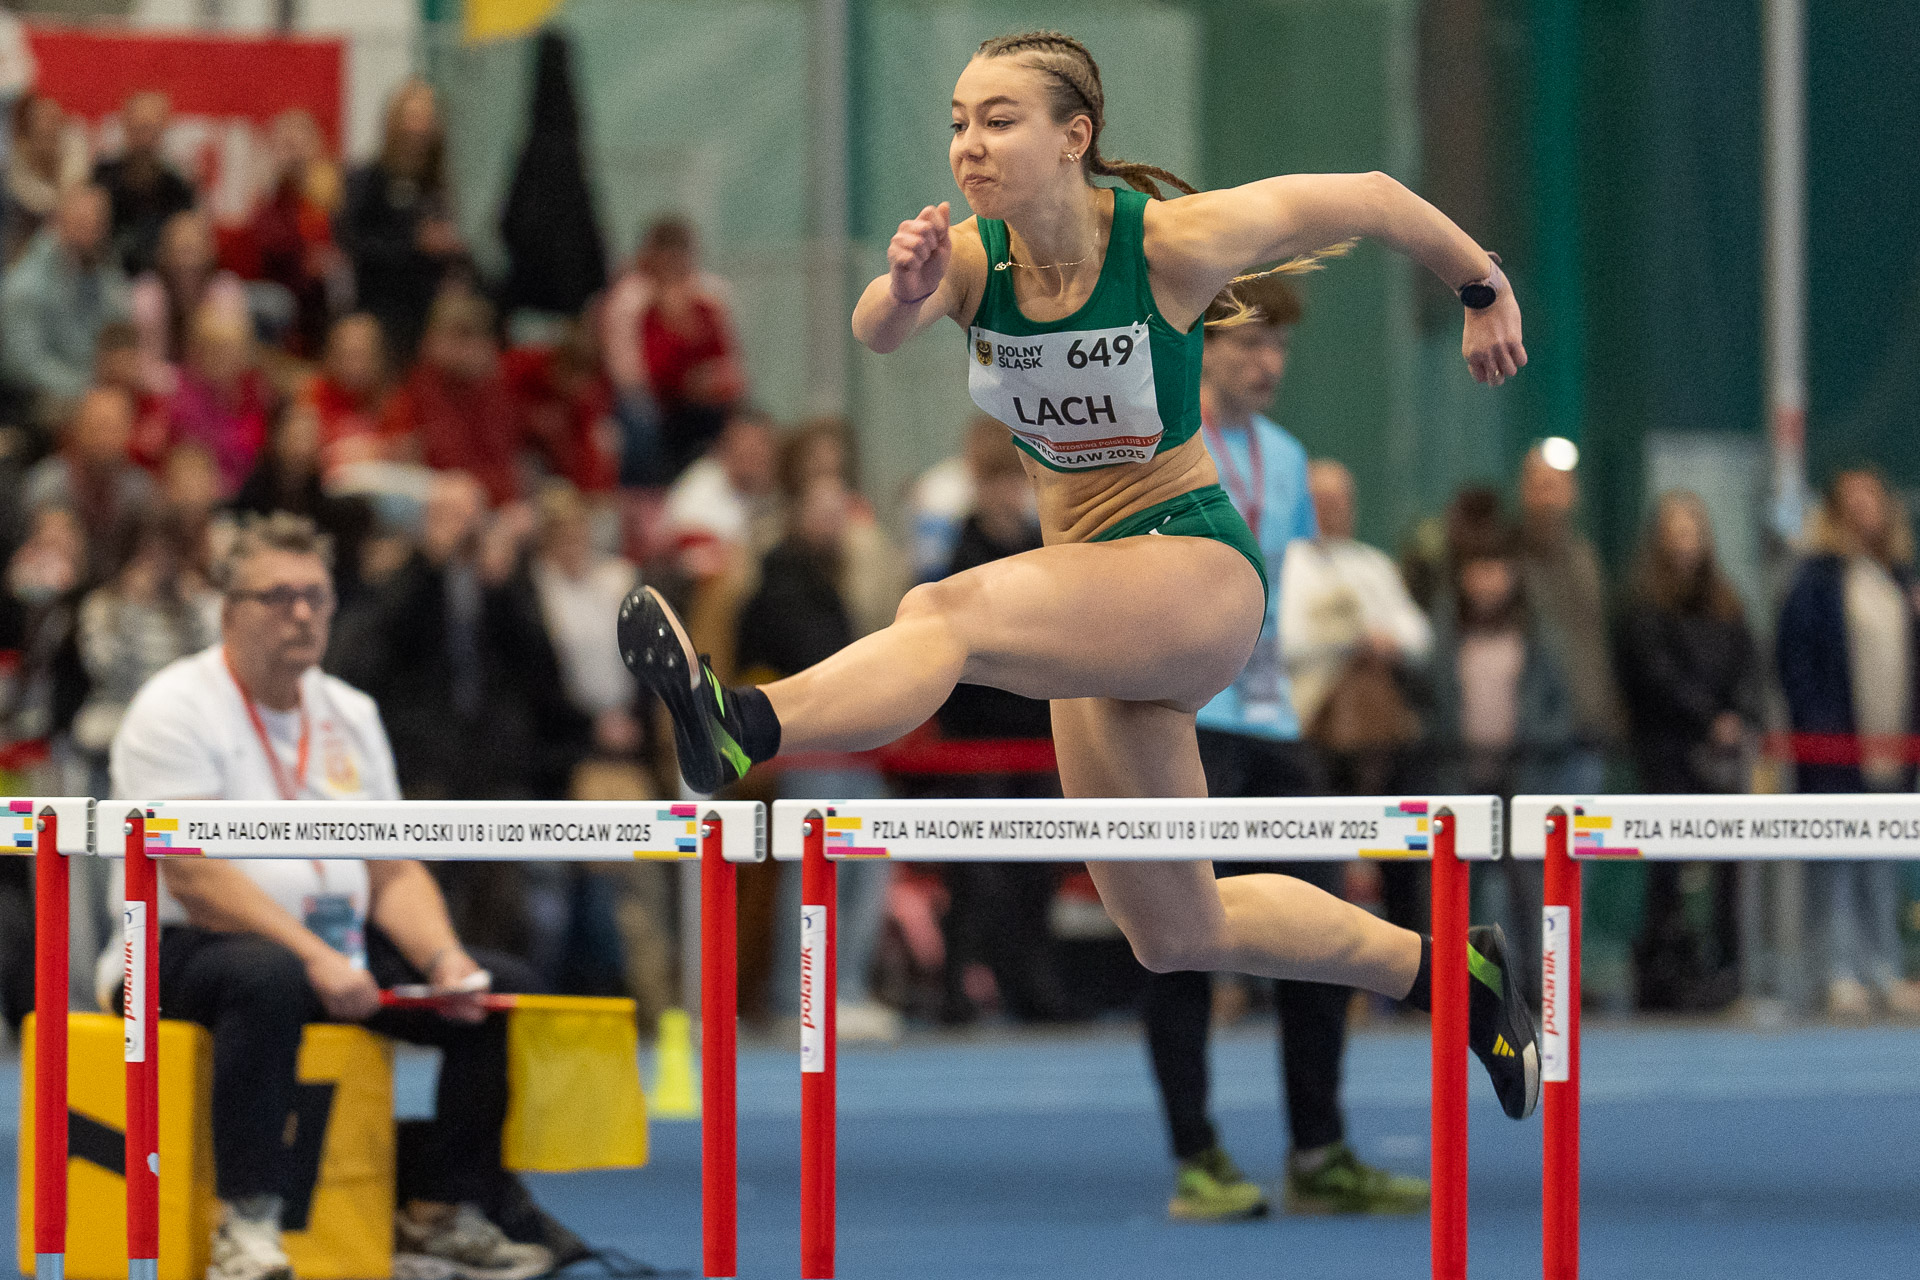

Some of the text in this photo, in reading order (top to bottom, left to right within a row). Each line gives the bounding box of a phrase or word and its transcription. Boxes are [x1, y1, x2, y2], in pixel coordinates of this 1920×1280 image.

[997, 343, 1044, 358] DOLNY
[1066, 334, 1134, 370] 649
[997, 355, 1044, 371] ŚLĄSK
[1012, 394, 1117, 426] LACH
[1028, 437, 1103, 465] WROCŁAW
[1107, 448, 1146, 459] 2025
[1099, 438, 1125, 448] Polski
[188, 822, 652, 842] PZLA HALOWE MISTRZOSTWA POLSKI U18 i U20 WROCŁAW 2025
[872, 819, 1380, 840] PZLA HALOWE MISTRZOSTWA POLSKI U18 i U20 WROCŁAW 2025
[1623, 818, 1920, 840] PZLA HALOWE MISTRZOSTWA POLS
[801, 946, 816, 1029] polanik
[1543, 950, 1559, 1036] polanik
